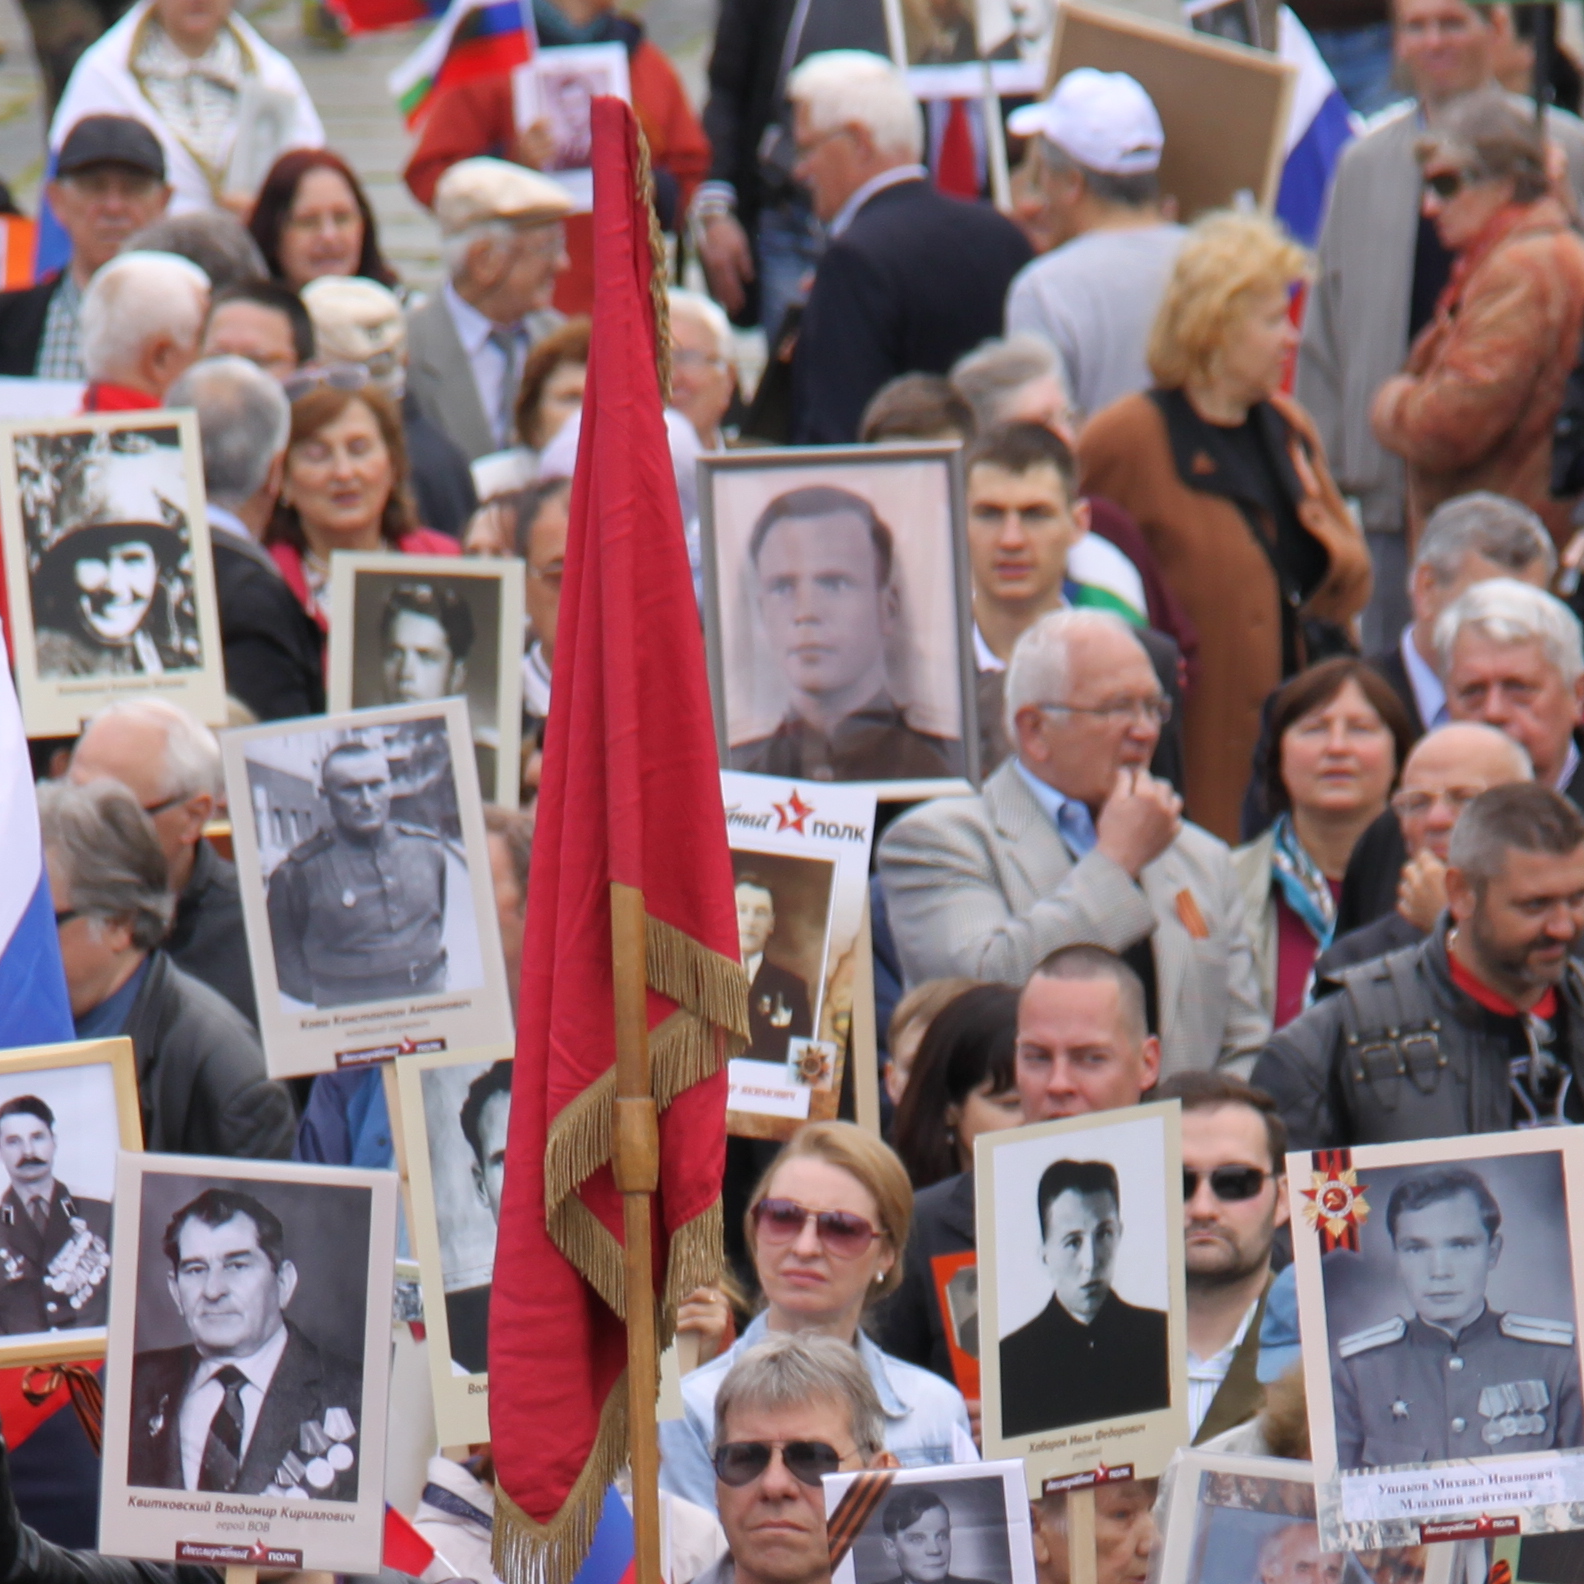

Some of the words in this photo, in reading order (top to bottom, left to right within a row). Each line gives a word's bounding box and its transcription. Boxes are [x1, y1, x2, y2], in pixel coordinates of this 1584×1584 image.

[1377, 1482, 1430, 1496] Ушаков
[1432, 1477, 1485, 1491] Михаил
[1488, 1469, 1554, 1486] Иванович
[128, 1495, 211, 1513] Квитковский
[214, 1502, 277, 1518] Владимир
[280, 1507, 356, 1523] Кириллович
[1400, 1496, 1464, 1510] Младший
[1466, 1489, 1535, 1504] лейтенант
[247, 1521, 271, 1533] ВОВ
